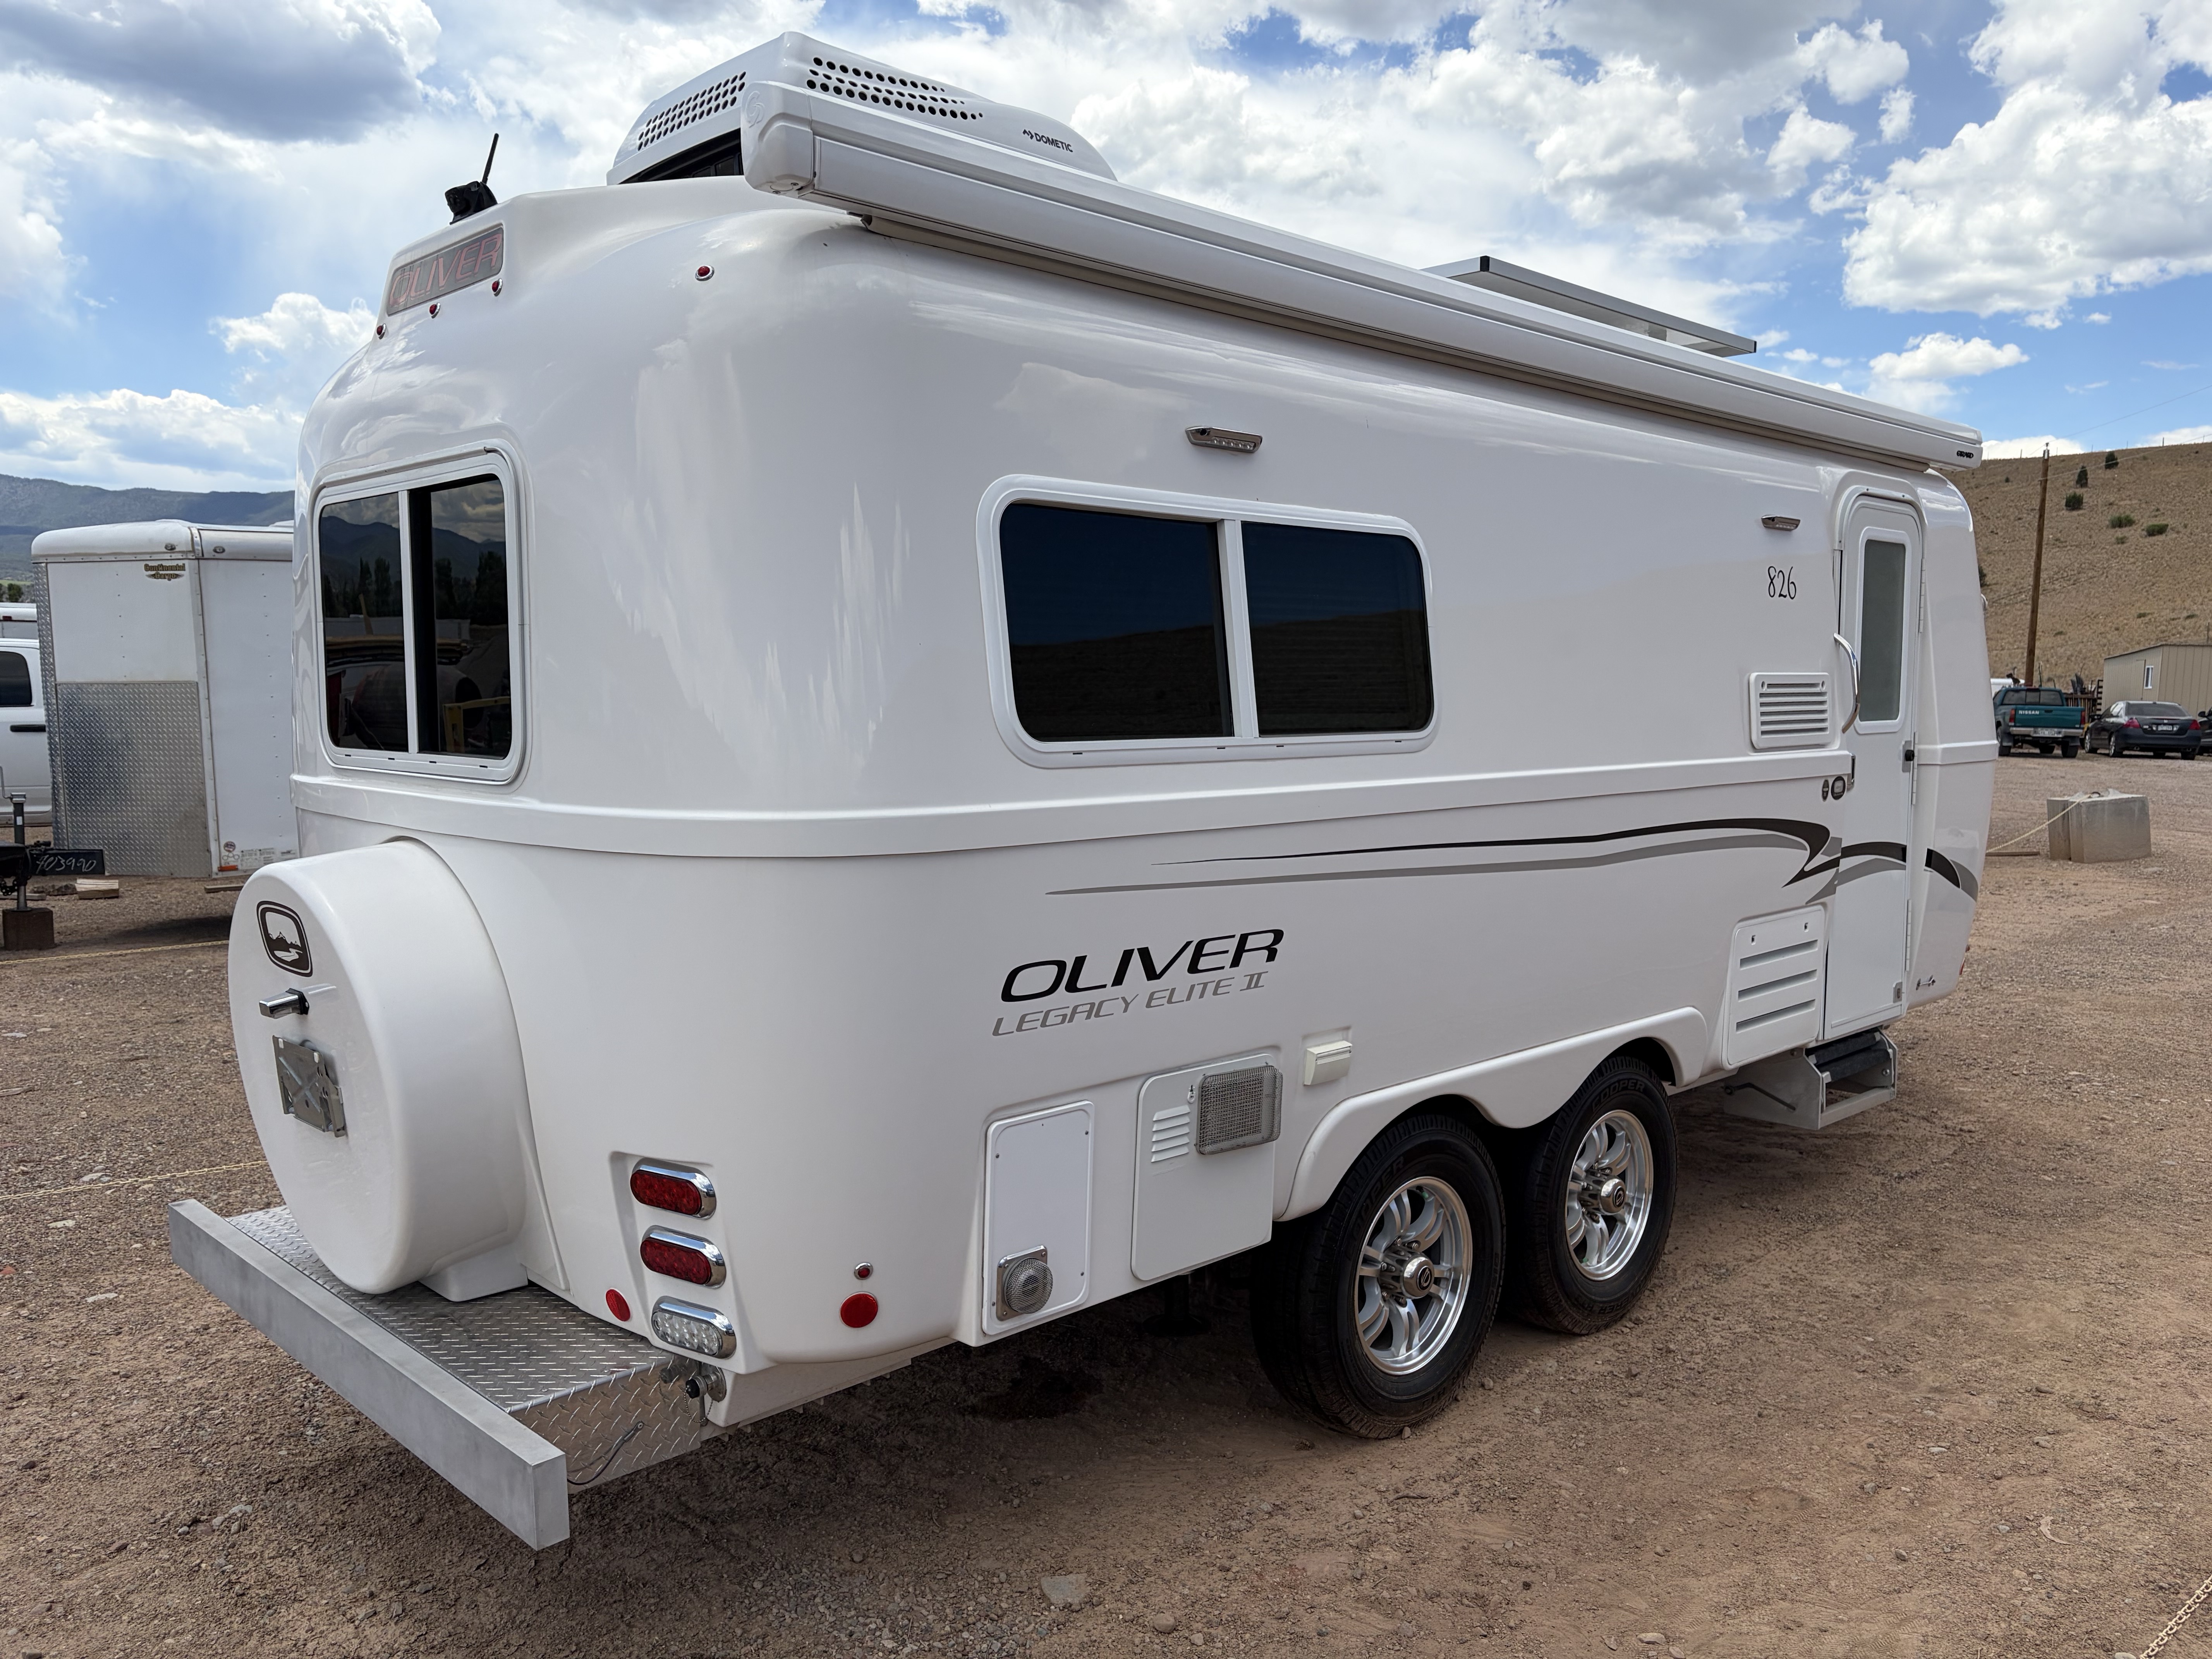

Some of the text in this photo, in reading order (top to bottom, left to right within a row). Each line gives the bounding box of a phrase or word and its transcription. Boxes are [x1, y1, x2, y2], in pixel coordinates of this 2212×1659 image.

[1034, 132, 1073, 153] DOMETIC
[389, 233, 503, 307] OLIVER
[1768, 566, 1796, 600] 826
[1001, 929, 1285, 1003] OLIVER
[992, 971, 1269, 1037] LEGACY ELITE II
[1592, 1079, 1645, 1112] COOPER
